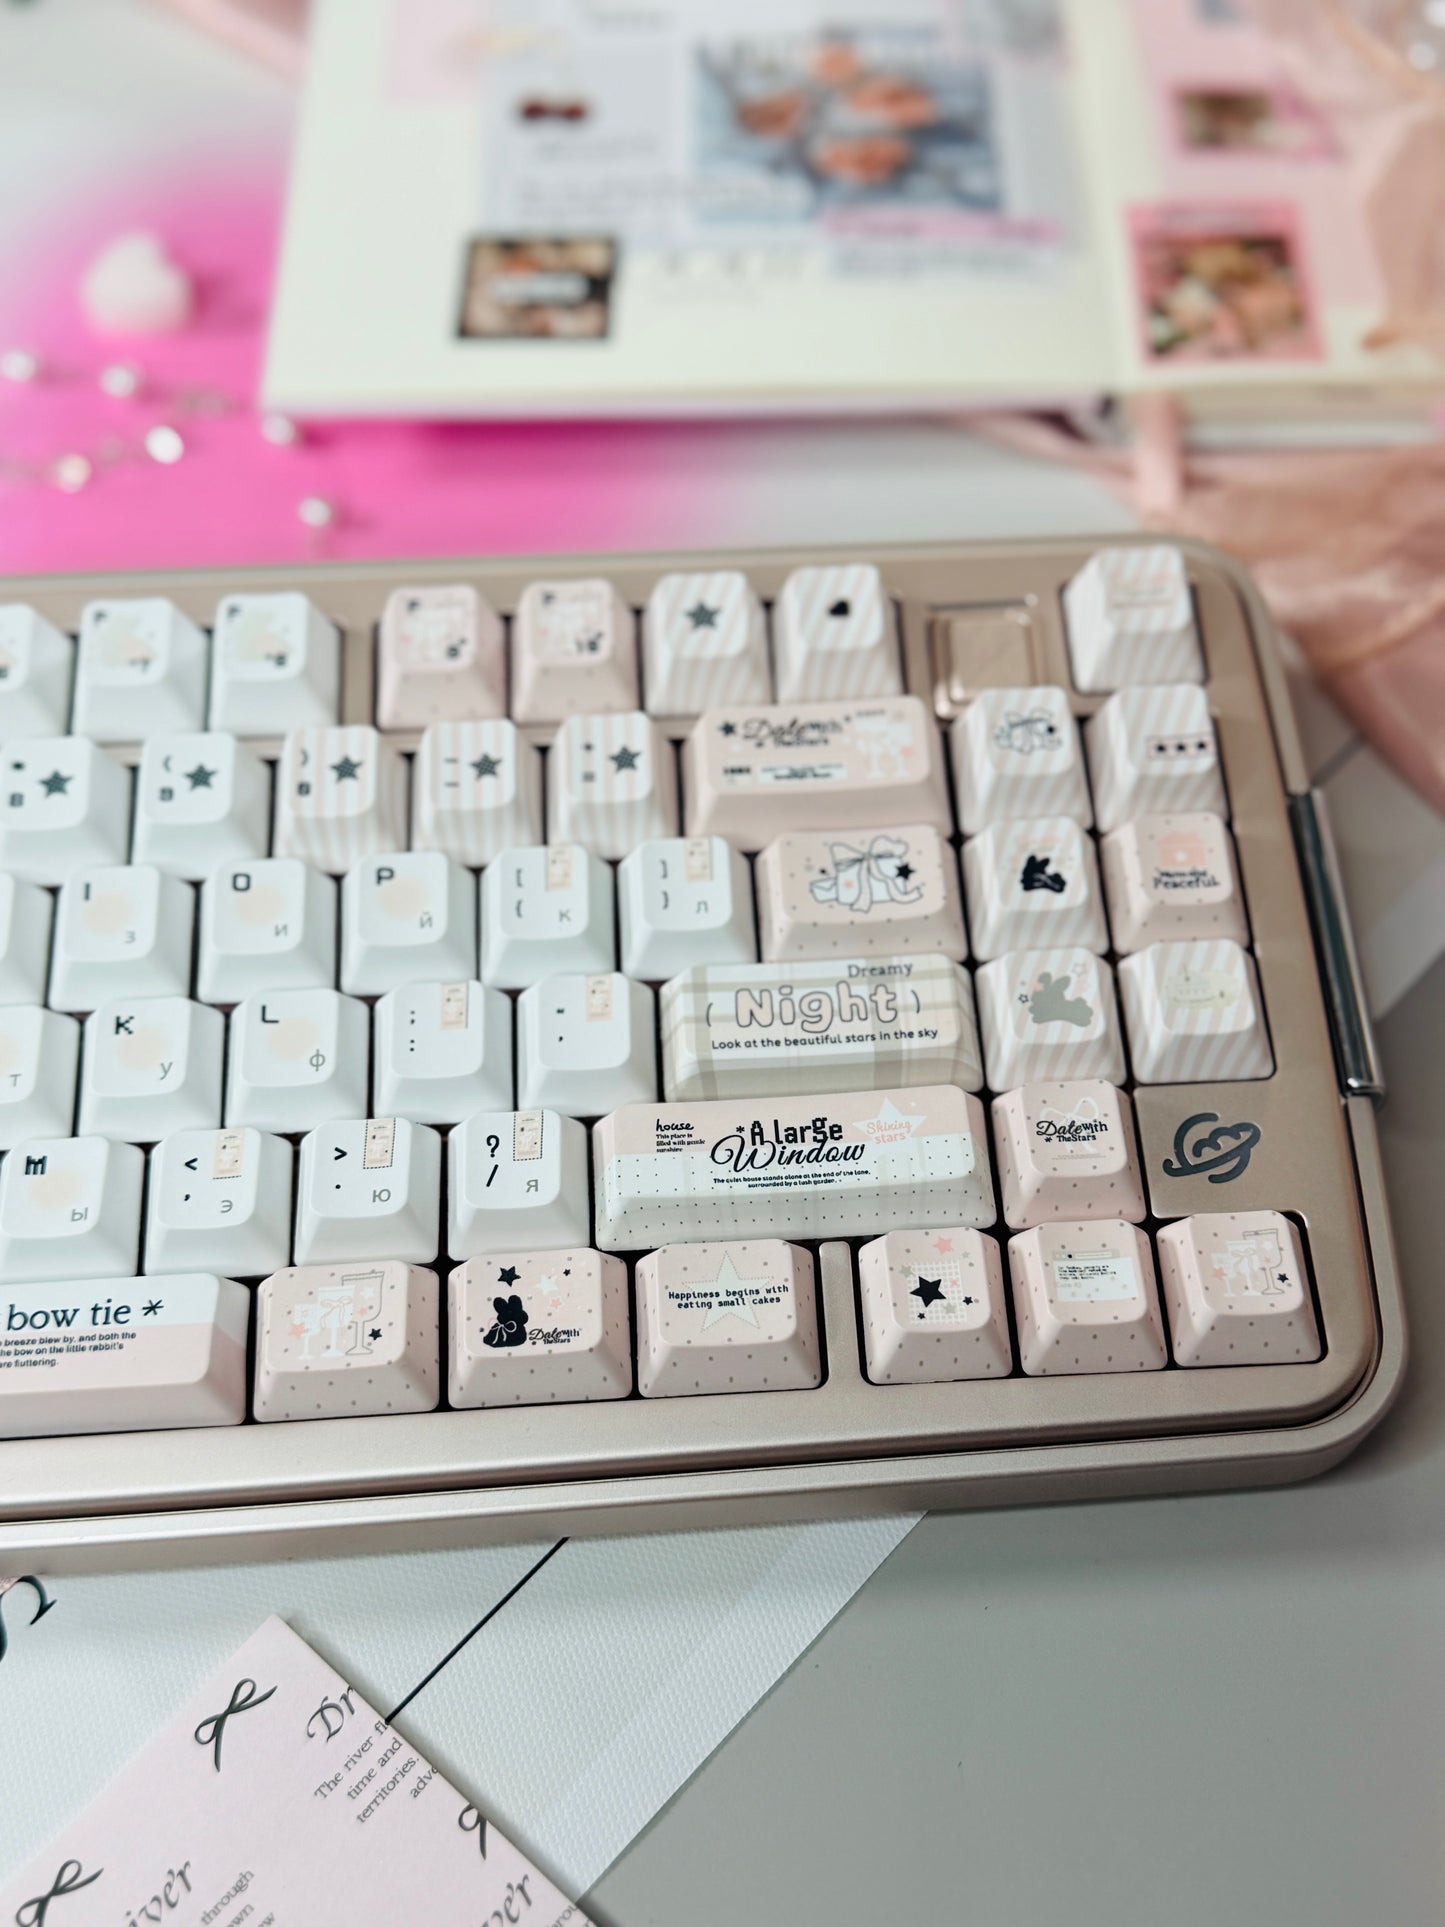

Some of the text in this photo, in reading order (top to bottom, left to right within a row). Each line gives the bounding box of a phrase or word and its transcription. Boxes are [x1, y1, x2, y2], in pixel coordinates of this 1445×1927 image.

[232, 874, 251, 892] O
[376, 867, 395, 885] P
[848, 961, 914, 979] Dreamy
[261, 1005, 279, 1023] L
[735, 980, 898, 1034] Night
[114, 1016, 135, 1035] K
[712, 1028, 938, 1050] Look at the beautiful stars in the sky
[656, 1118, 694, 1132] house
[773, 1117, 843, 1145] large
[866, 1119, 912, 1135] Shining
[486, 1135, 500, 1158] ?
[874, 1133, 906, 1144] stars
[710, 1134, 866, 1173] Window
[668, 1284, 789, 1301] Happiness begins with
[677, 1296, 781, 1309] eating small cakes
[7, 1298, 131, 1331] bow tie
[4, 1337, 37, 1347] breeze
[38, 1335, 61, 1344] blew
[78, 1333, 97, 1342] and
[98, 1332, 119, 1342] both
[121, 1331, 136, 1340] the
[14, 1346, 33, 1356] bow
[35, 1347, 48, 1355] on
[49, 1345, 64, 1354] the
[66, 1343, 87, 1353] little
[89, 1341, 124, 1352] rabbit's
[306, 1685, 355, 1743] Dr
[314, 1772, 344, 1799] The
[343, 1736, 375, 1771] river
[347, 1737, 403, 1800] time and
[356, 1757, 420, 1823] territories.
[201, 1869, 255, 1926] through
